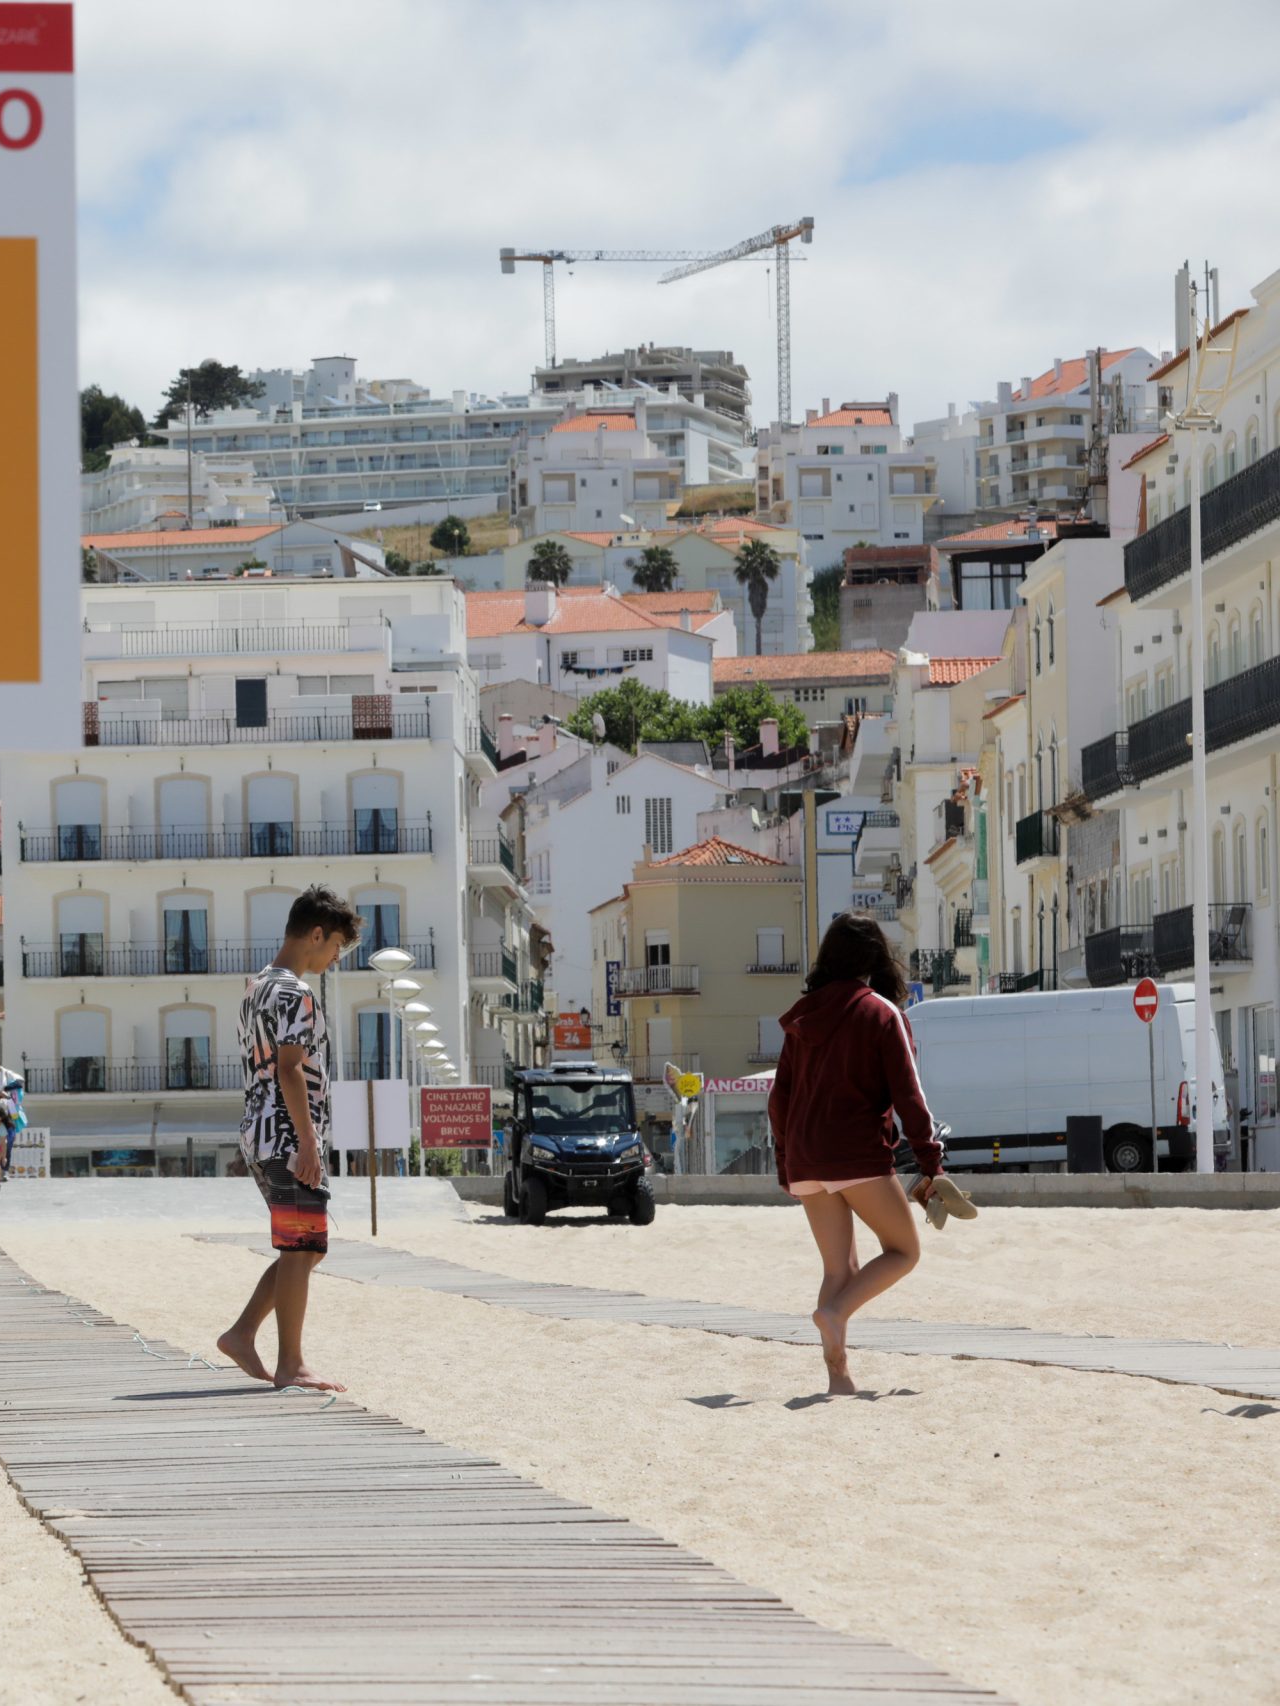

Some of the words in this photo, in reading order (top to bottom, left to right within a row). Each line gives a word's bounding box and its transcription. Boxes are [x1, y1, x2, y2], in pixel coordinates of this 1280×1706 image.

[563, 1032, 580, 1045] 24
[426, 1092, 448, 1101] CINE
[451, 1091, 486, 1101] TEATRO
[430, 1103, 443, 1112] DA
[445, 1101, 483, 1112] NAZARÉ
[423, 1114, 473, 1123] VOLTAMOS
[475, 1114, 489, 1123] EM
[440, 1127, 471, 1136] BREVE
